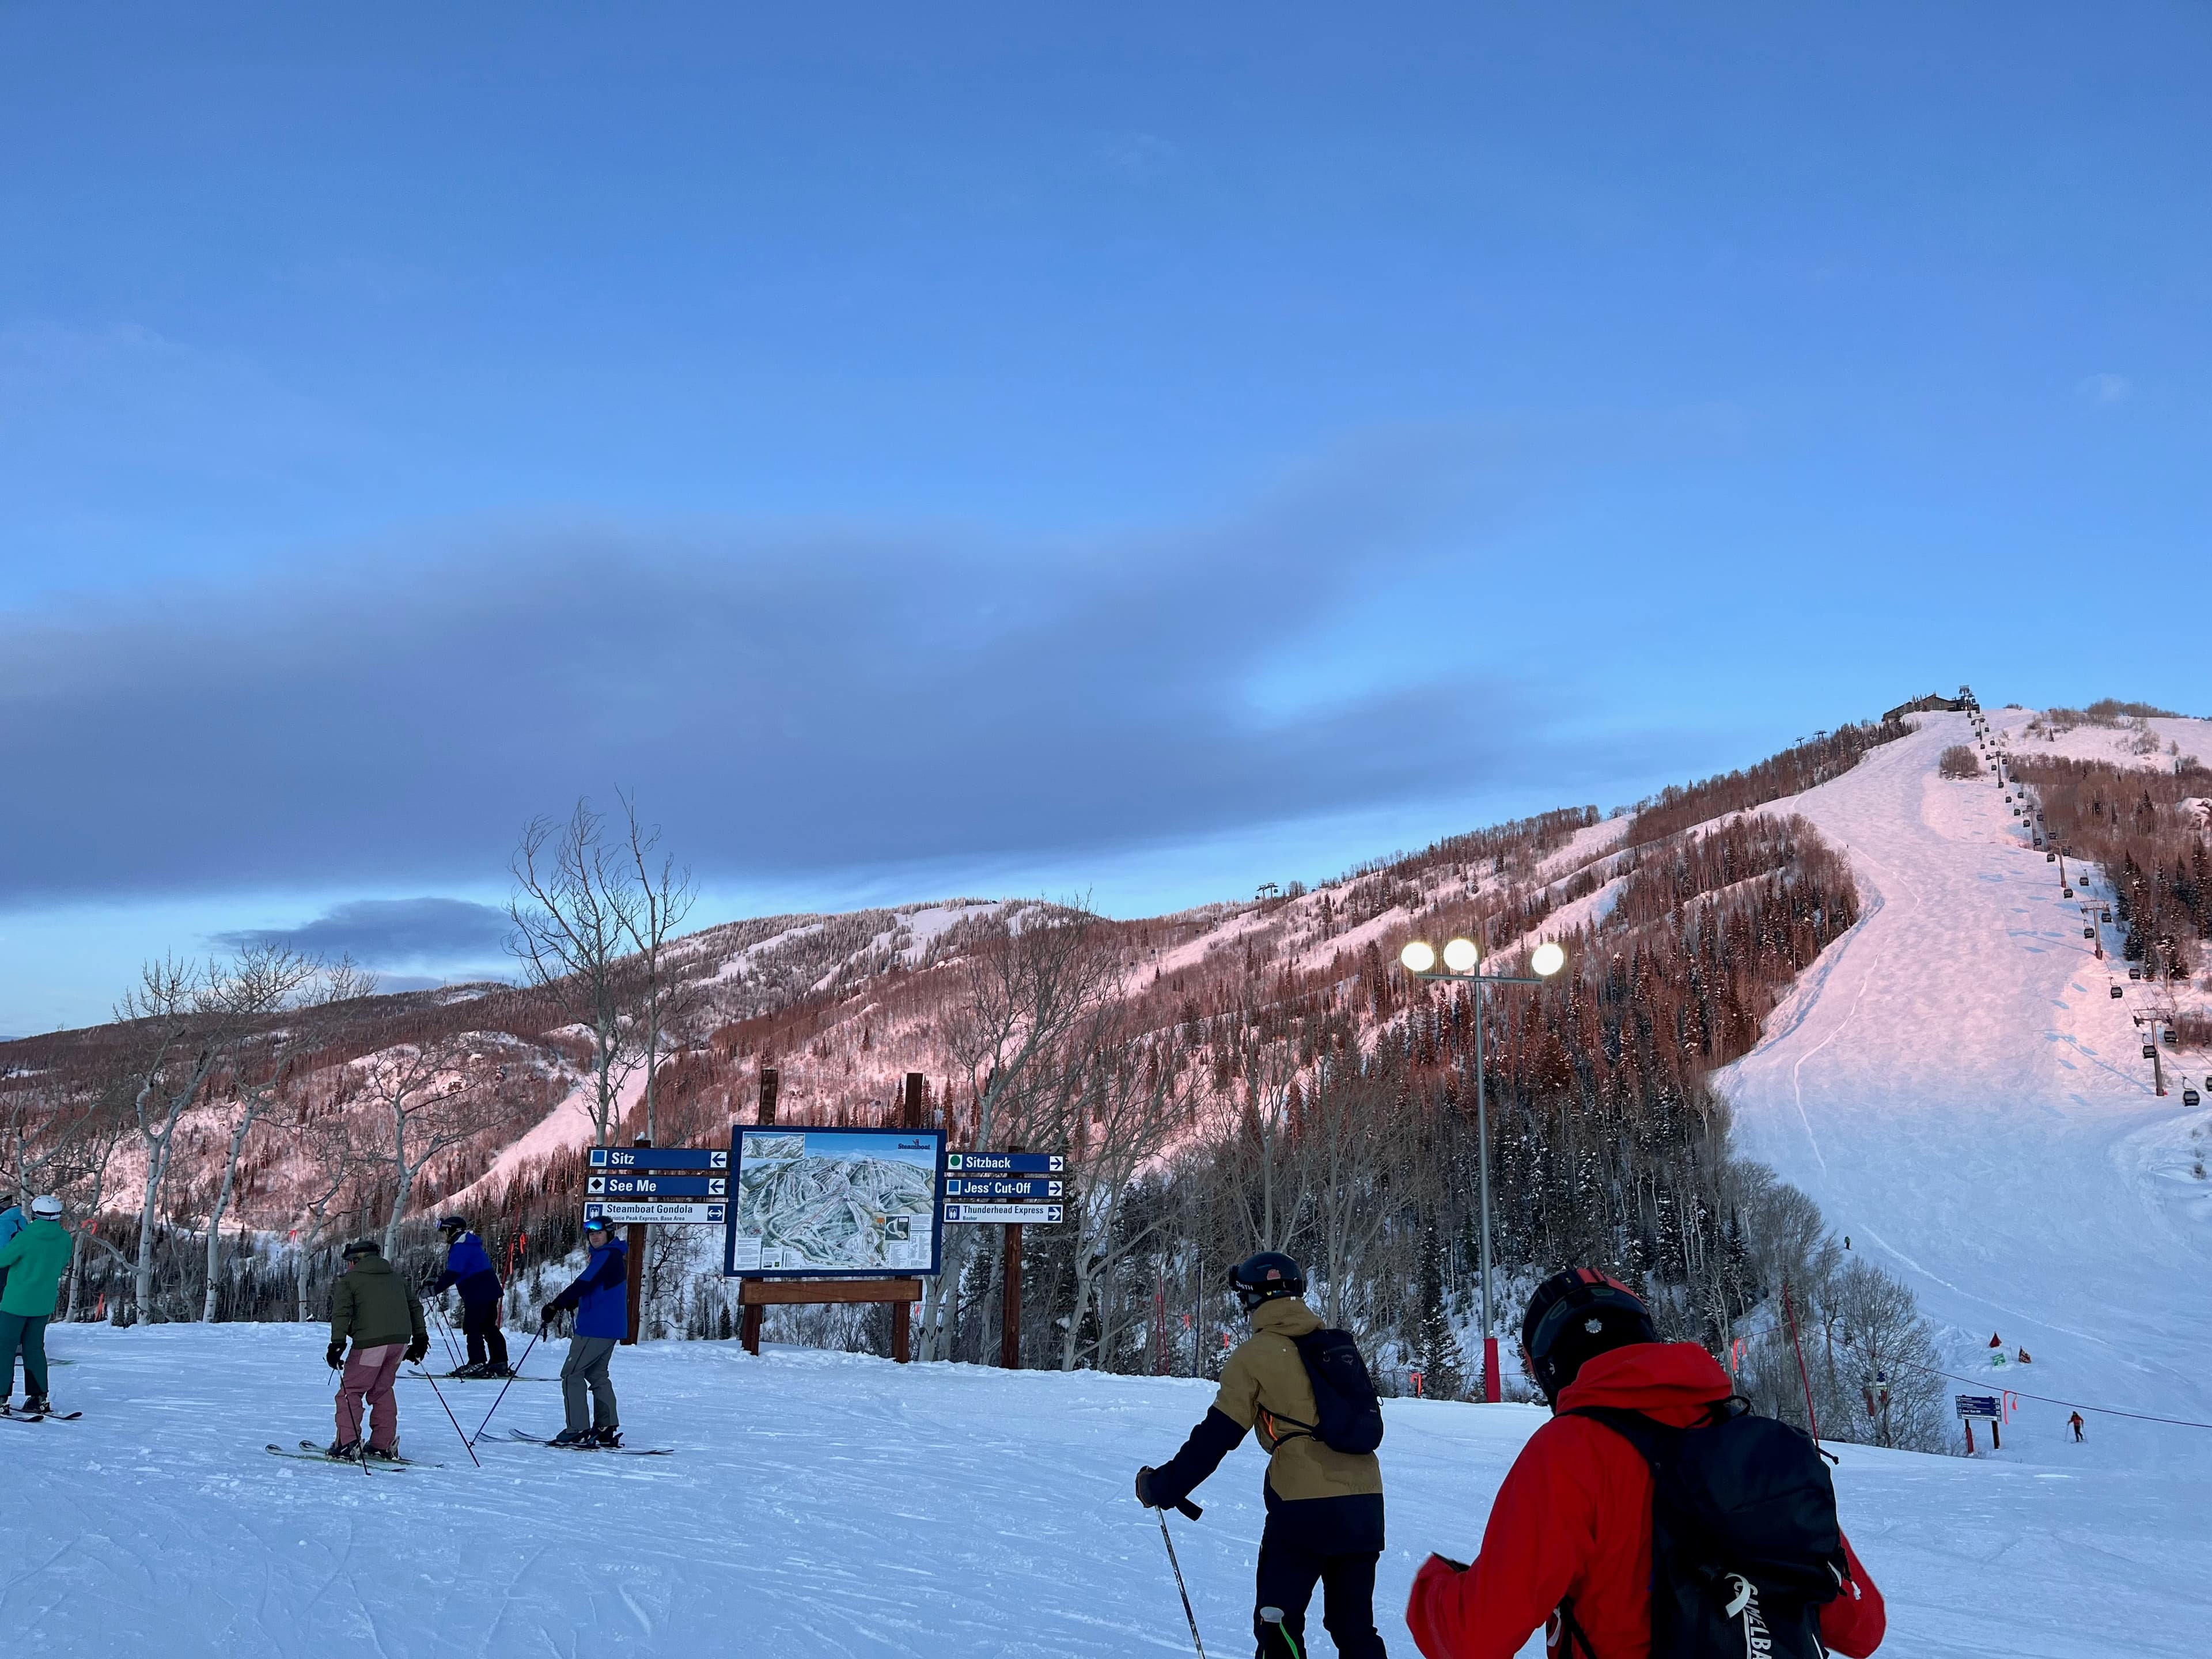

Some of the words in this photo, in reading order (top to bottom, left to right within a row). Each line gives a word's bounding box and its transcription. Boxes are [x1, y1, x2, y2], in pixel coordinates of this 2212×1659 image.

[611, 1152, 634, 1165] Sitz
[966, 1156, 1011, 1168] Sitzback
[609, 1179, 633, 1192] See
[637, 1180, 657, 1192] Me
[995, 1182, 1031, 1194] Cut-Off
[607, 1204, 654, 1213] Steamboat
[657, 1205, 692, 1214] Gondola
[963, 1205, 1012, 1214] Thunderhead
[1014, 1206, 1044, 1215] Express
